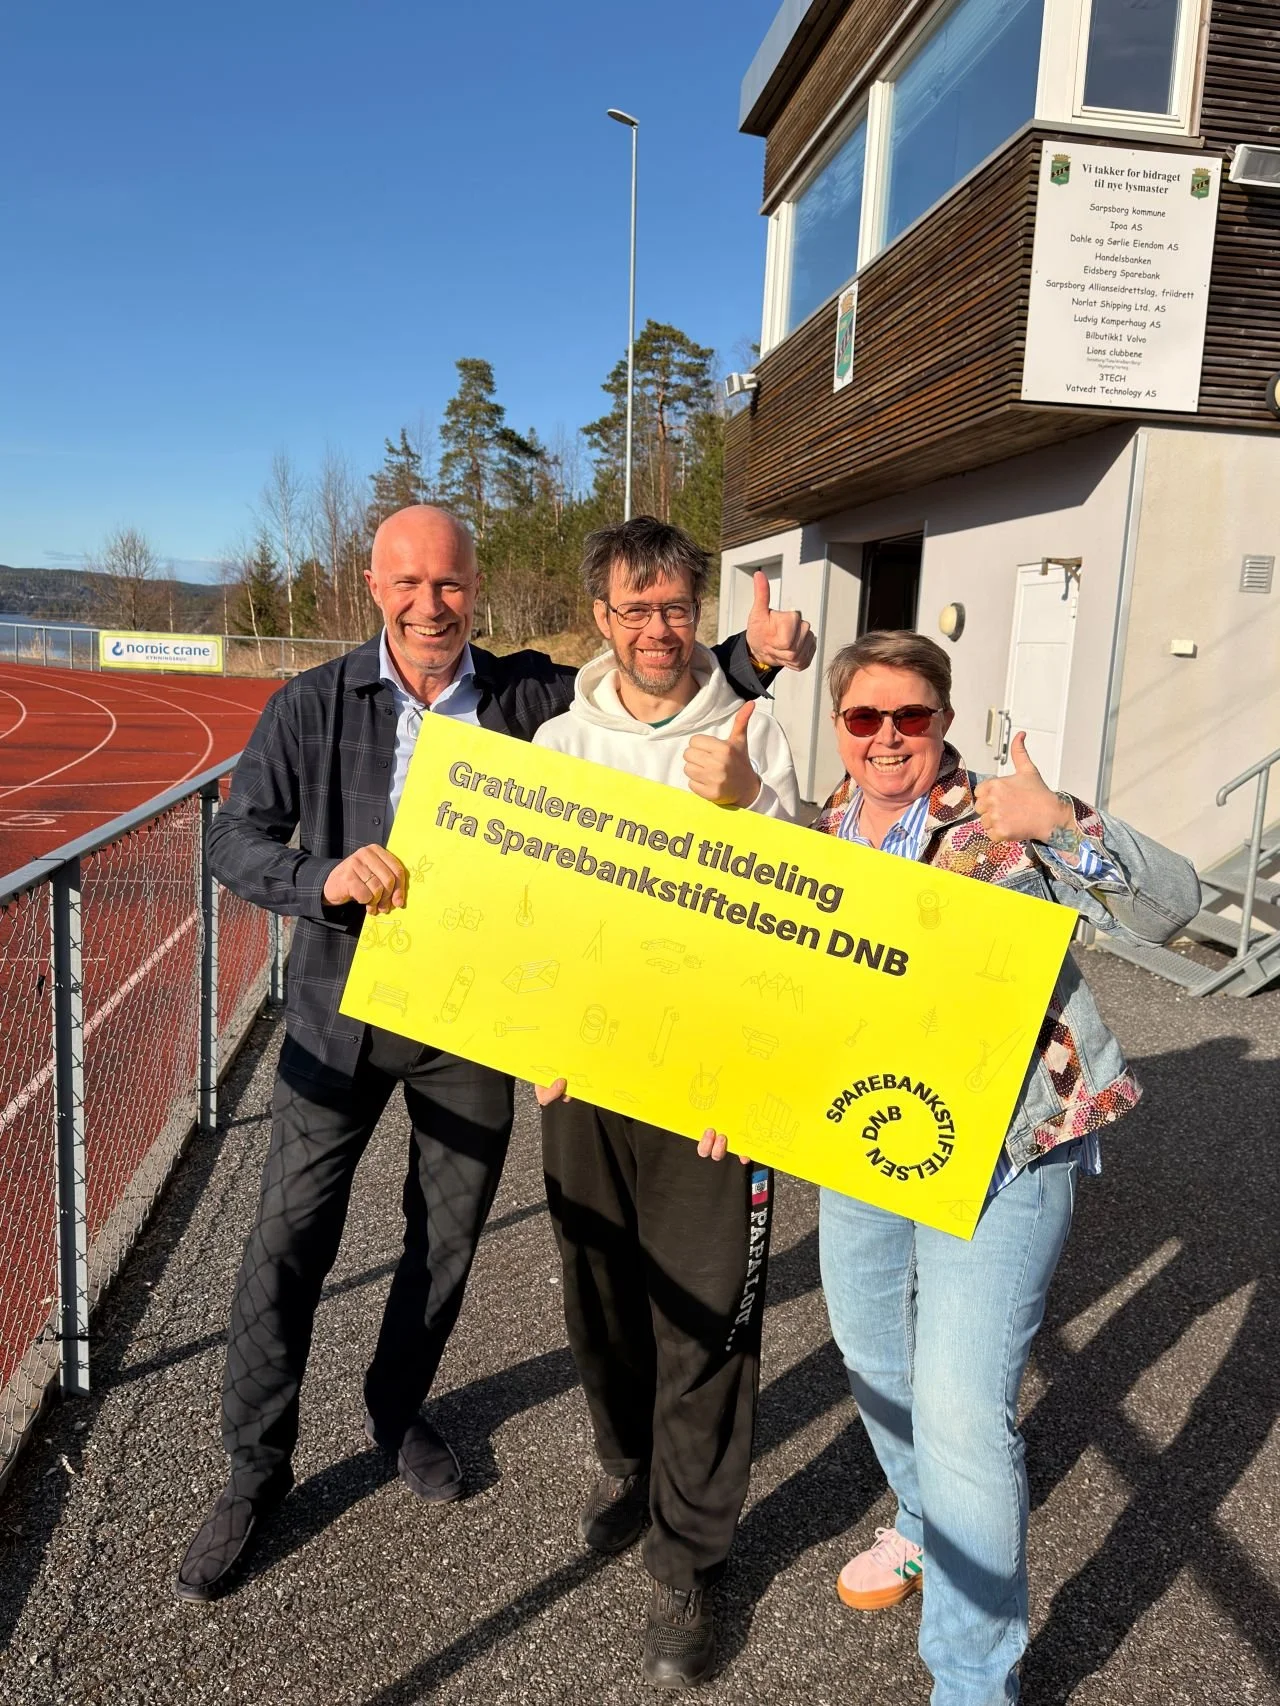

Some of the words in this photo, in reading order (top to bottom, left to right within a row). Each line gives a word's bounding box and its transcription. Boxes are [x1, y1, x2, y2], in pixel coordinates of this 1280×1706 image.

[1082, 164, 1092, 173] Vi
[1095, 165, 1125, 177] takker
[1127, 169, 1140, 178] for
[1143, 169, 1180, 182] bidraget
[1094, 179, 1104, 188] til
[1108, 182, 1123, 191] nye
[1125, 181, 1168, 194] lysmaster
[1089, 204, 1129, 216] Sarpsborg
[1132, 207, 1166, 217] kommune
[1110, 222, 1127, 231] Ipoa
[1070, 234, 1092, 244] Dahle
[1095, 238, 1104, 246] og
[1107, 238, 1130, 247] Sørlie
[1133, 240, 1164, 250] Eiendom
[1167, 243, 1179, 251] AS
[1095, 253, 1151, 265] Handelsbanken
[1084, 266, 1117, 278] Eidsberg
[1120, 269, 1160, 280] Sparebank
[1046, 280, 1085, 292] Sarpsborg
[1089, 283, 1158, 298] Allianseidrettslag,
[1162, 290, 1194, 299] friidrett
[1072, 298, 1096, 307] Norlat
[1100, 300, 1132, 312] Shipping
[1135, 303, 1150, 312] Ltd.
[1074, 315, 1098, 325] Ludvig
[1101, 317, 1147, 329] Kamperhaug
[1150, 320, 1161, 328] AS
[1127, 335, 1146, 343] Volvo
[1087, 347, 1106, 355] Lions
[1110, 349, 1142, 358] clubbene
[1099, 374, 1126, 382] 3TECH
[1066, 384, 1096, 393] Vatvedt
[1100, 386, 1142, 398] Technology
[1145, 390, 1157, 398] AS
[173, 645, 210, 656] crane
[448, 761, 613, 834] Gratulerer
[616, 819, 694, 858] med
[698, 840, 844, 914] tildeling
[435, 802, 477, 838] fra
[484, 820, 820, 949] Sparebankstiftelsen
[826, 929, 909, 977] DNB
[826, 1073, 955, 1181] SPAREBANKSTIFTELSEN
[862, 1105, 902, 1141] DNB
